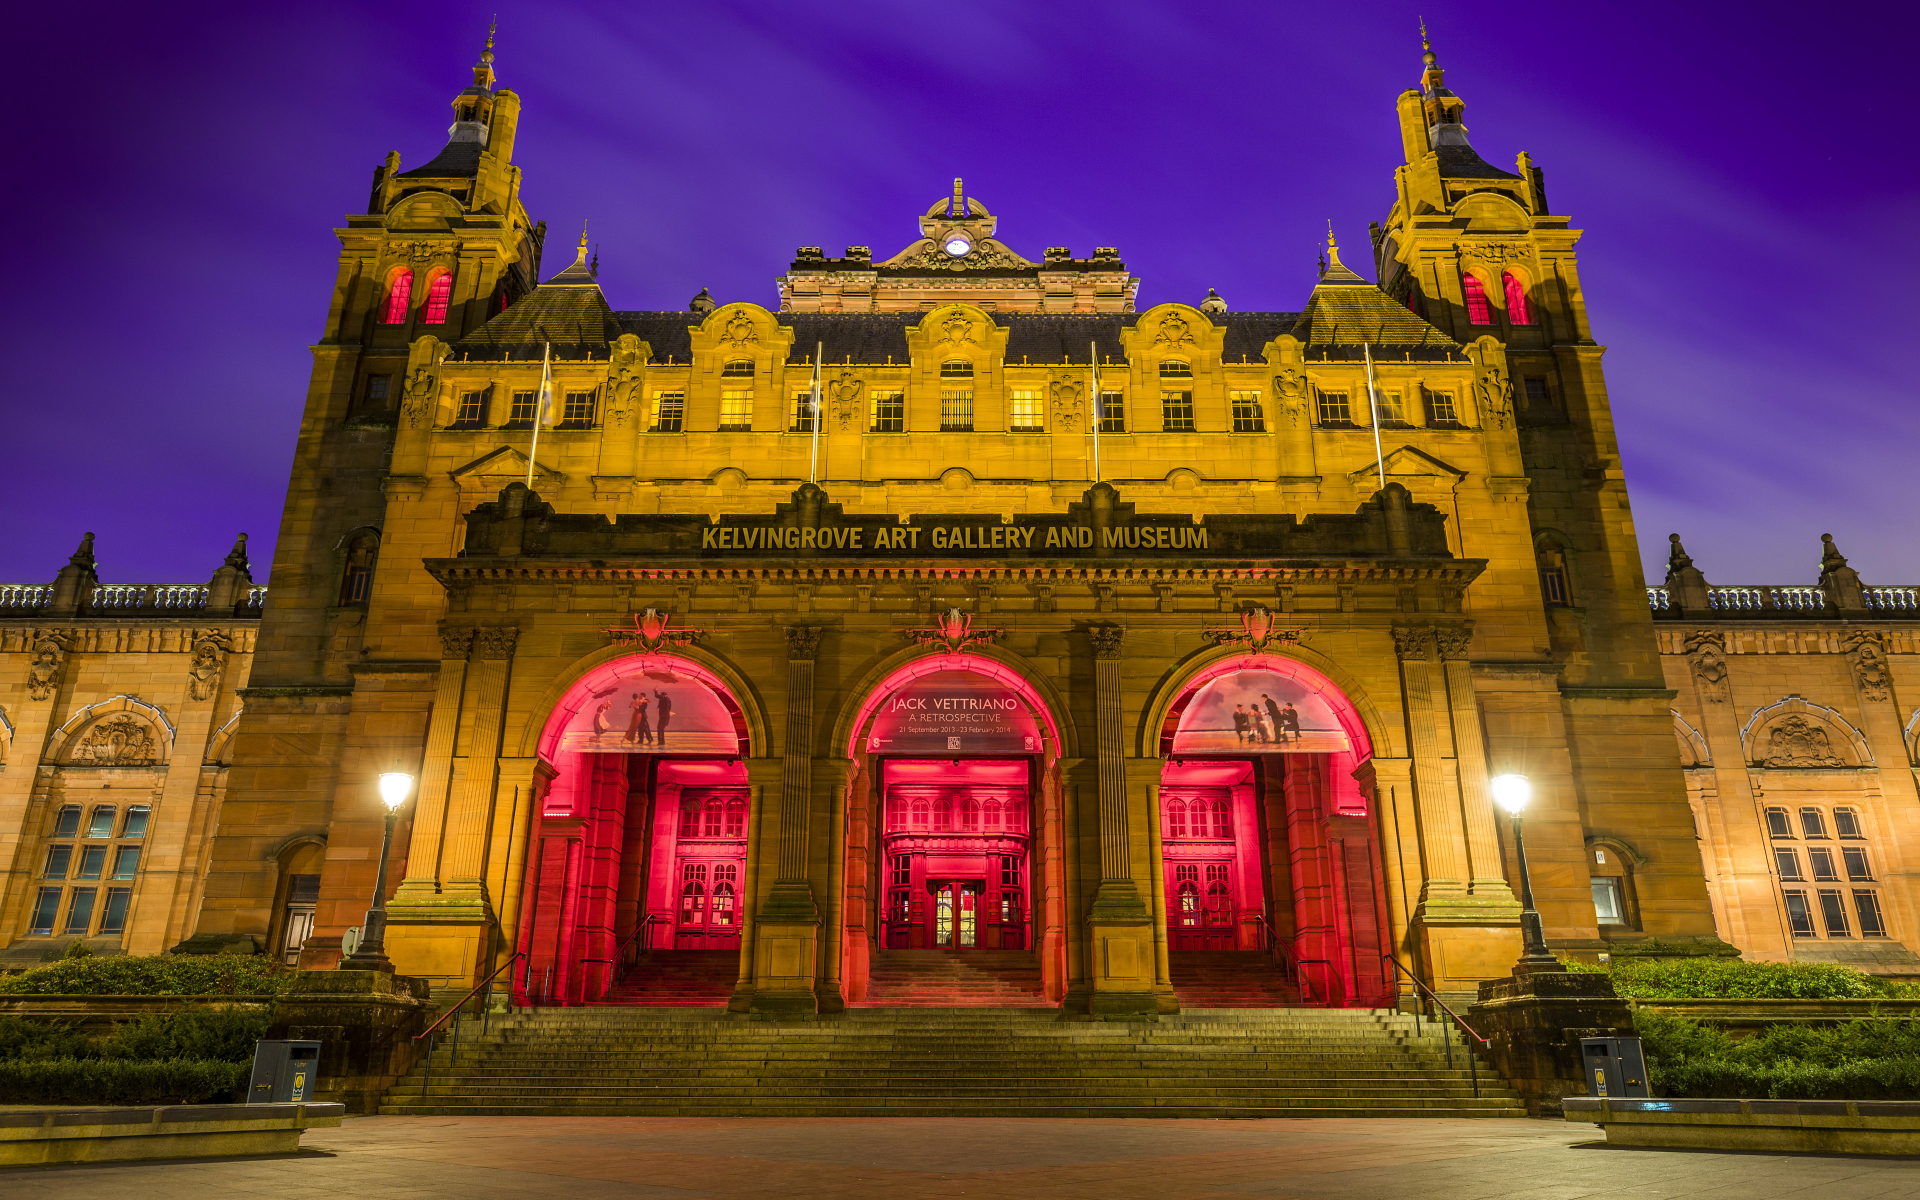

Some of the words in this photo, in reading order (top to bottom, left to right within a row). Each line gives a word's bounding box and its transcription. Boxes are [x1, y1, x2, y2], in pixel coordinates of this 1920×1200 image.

[702, 527, 863, 549] KELVINGROVE
[874, 527, 922, 549] ART
[932, 527, 1036, 549] GALLERY
[1044, 527, 1094, 549] AND
[1102, 527, 1209, 549] MUSEUM
[891, 698, 927, 713] JACK
[933, 698, 1017, 710] VETTRIANO
[908, 713, 917, 722] A
[920, 713, 1001, 722] RETROSPECTIVE
[908, 726, 939, 735] September
[968, 726, 994, 735] February
